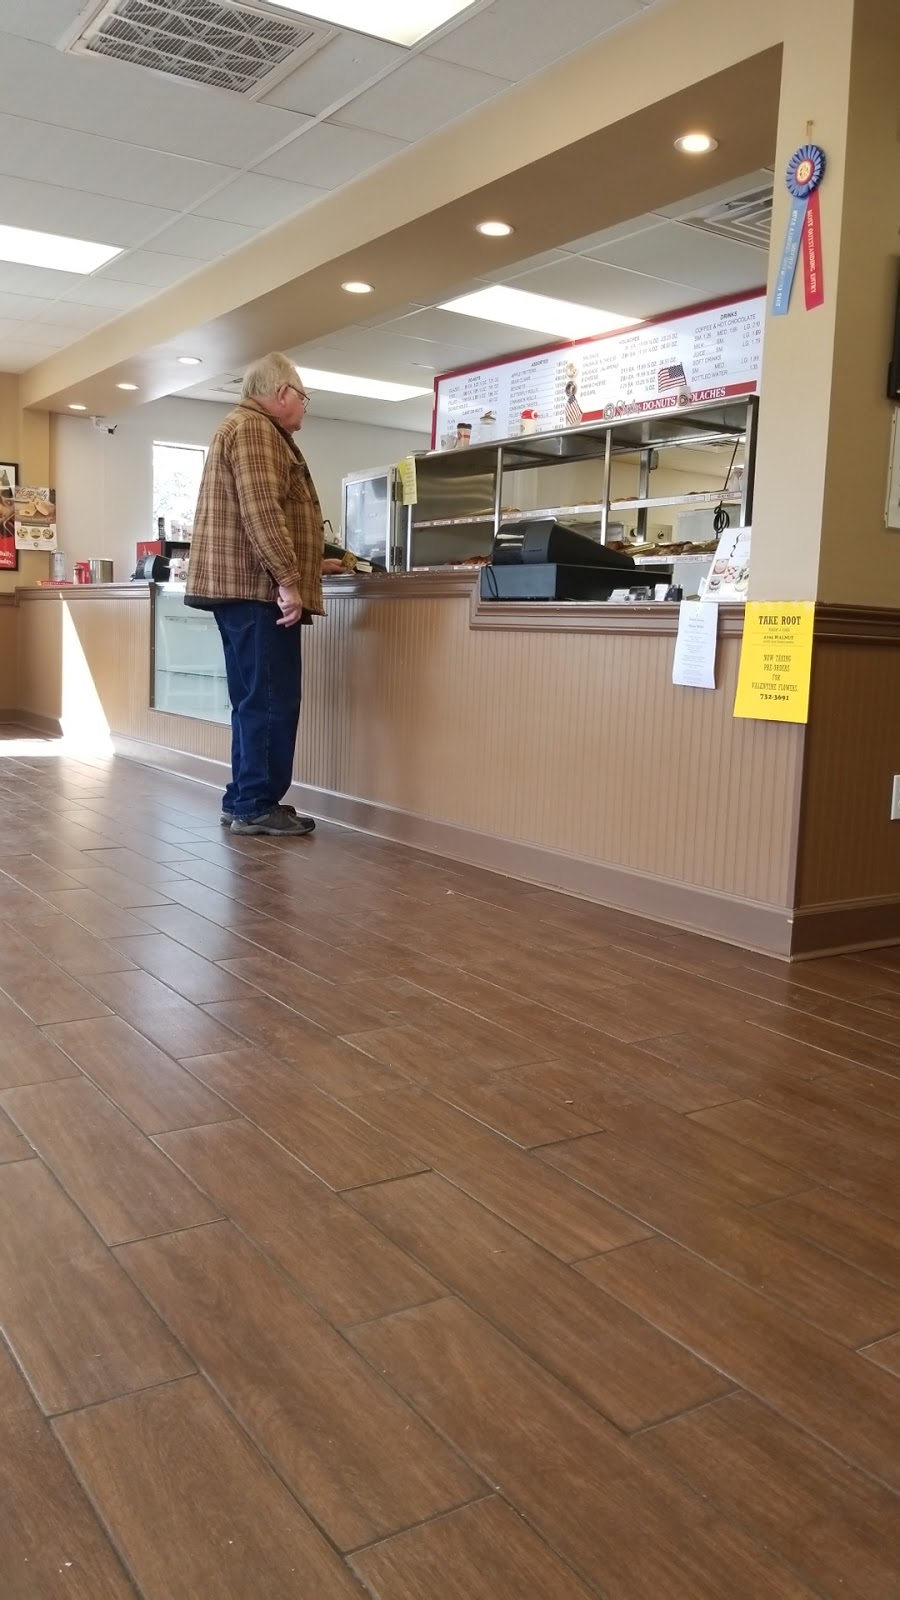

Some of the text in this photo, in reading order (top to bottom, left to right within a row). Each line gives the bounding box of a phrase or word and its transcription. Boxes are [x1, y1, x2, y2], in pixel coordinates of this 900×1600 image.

[720, 311, 737, 320] DRINKS
[695, 324, 712, 334] COFFEE
[727, 313, 756, 326] CHOCOLATE
[705, 354, 721, 363] DRINKS
[642, 396, 677, 411] DO-NUTS
[690, 388, 726, 402] OLACHES
[758, 616, 801, 626] TAKE ROOT
[764, 664, 790, 672] PRE-ORDERS
[752, 682, 777, 690] VALENTINE
